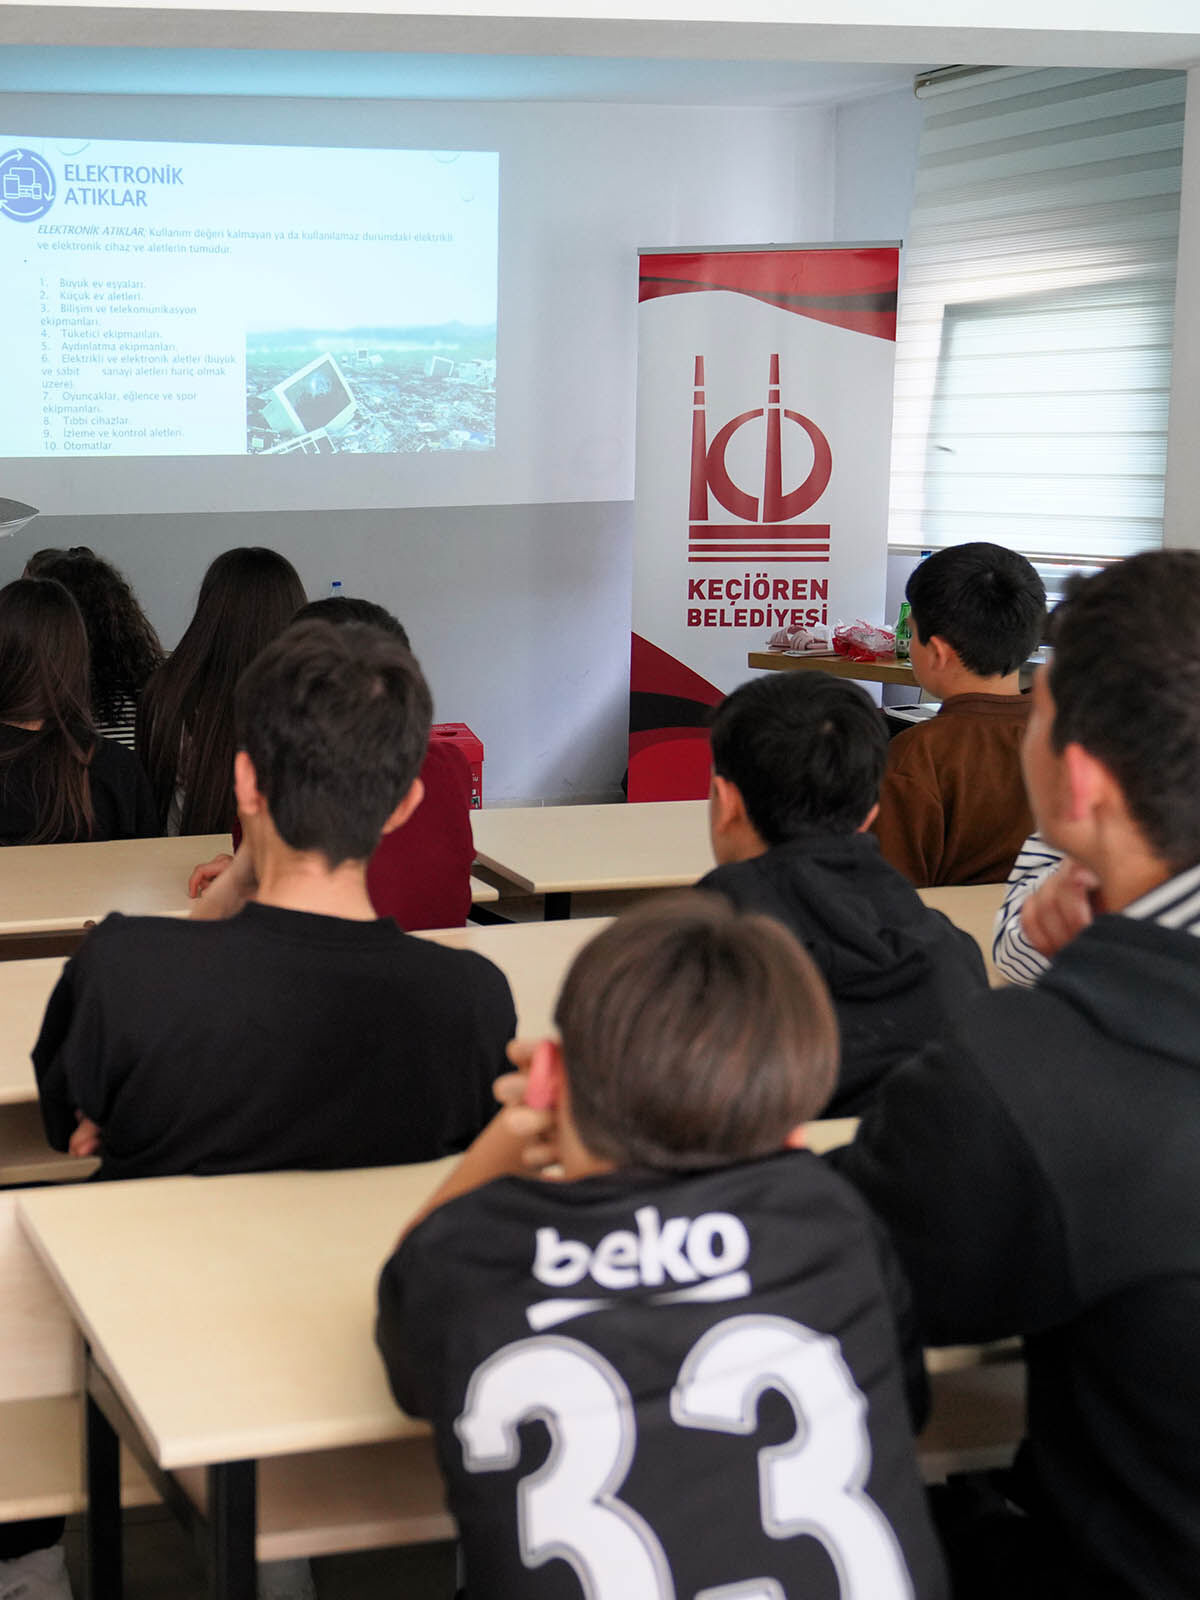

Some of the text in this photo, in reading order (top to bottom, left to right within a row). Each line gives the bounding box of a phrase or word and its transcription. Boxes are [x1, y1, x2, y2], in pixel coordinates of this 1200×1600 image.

[64, 164, 184, 185] ELEKTRONİK
[64, 188, 148, 207] ATIKLAR
[37, 224, 100, 236] ELEKTRONİK
[51, 241, 101, 251] elektronik
[104, 241, 131, 252] cihaz
[93, 293, 104, 301] ev
[41, 368, 53, 376] ve
[56, 366, 81, 376] sabit
[101, 367, 133, 379] sanayi
[197, 367, 226, 376] olmak
[99, 430, 110, 438] ve
[112, 428, 147, 438] kontrol
[687, 572, 829, 606] KEÇİÖREN
[687, 603, 828, 628] BELEDİYESİ
[531, 1205, 751, 1289] beko
[453, 1313, 917, 1600] 33
